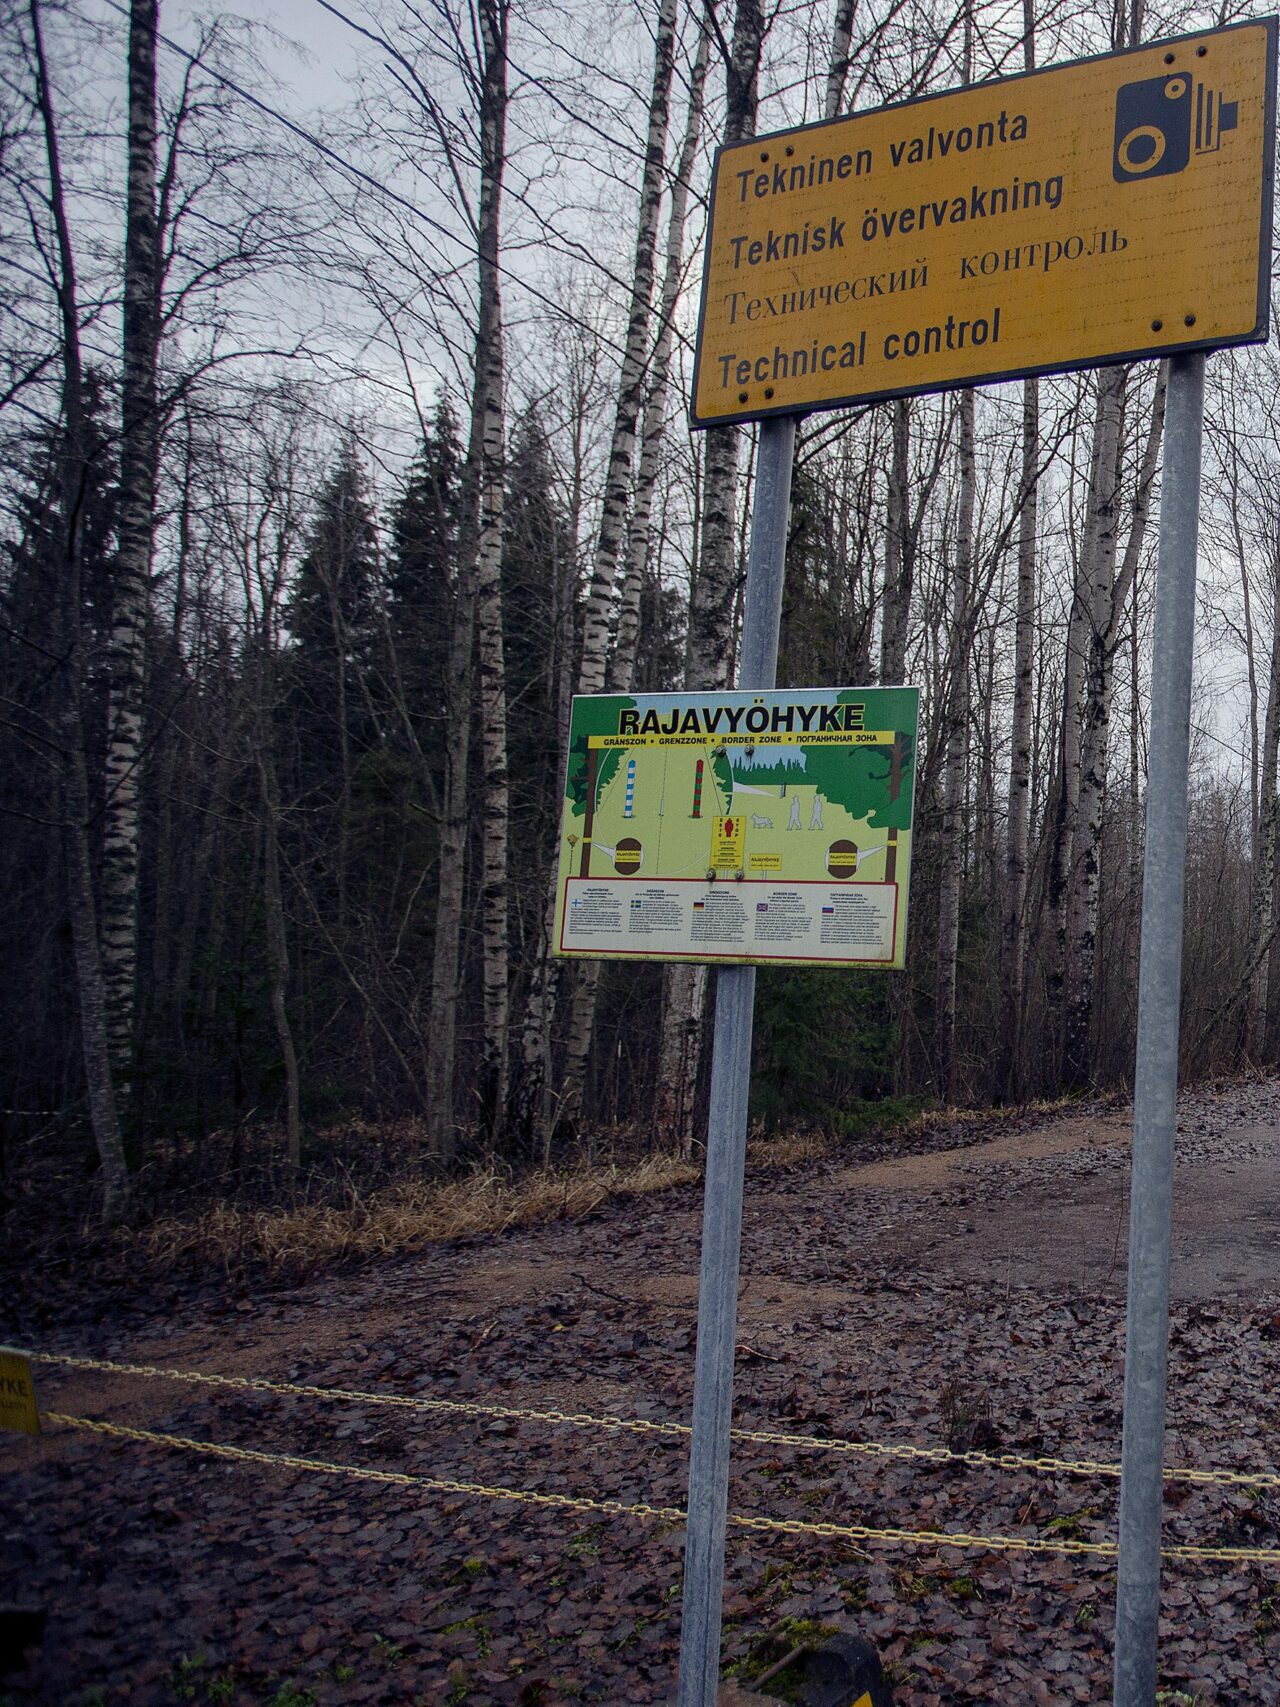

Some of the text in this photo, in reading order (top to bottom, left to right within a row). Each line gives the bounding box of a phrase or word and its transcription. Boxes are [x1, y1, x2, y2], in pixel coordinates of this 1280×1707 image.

[736, 111, 1027, 203] Tekninen valvonta
[730, 175, 1063, 269] Teknisk övervakning
[724, 230, 1127, 325] Технический контроль
[718, 308, 1000, 387] Technical control
[619, 699, 865, 735] RAJAVYÖHYKE
[658, 737, 708, 745] GRENZZONE
[721, 736, 755, 744] BORDER
[759, 736, 782, 744] ZONE
[796, 734, 852, 743] ПОГРАНИЧНАЯ
[855, 734, 877, 743] ЗОНА
